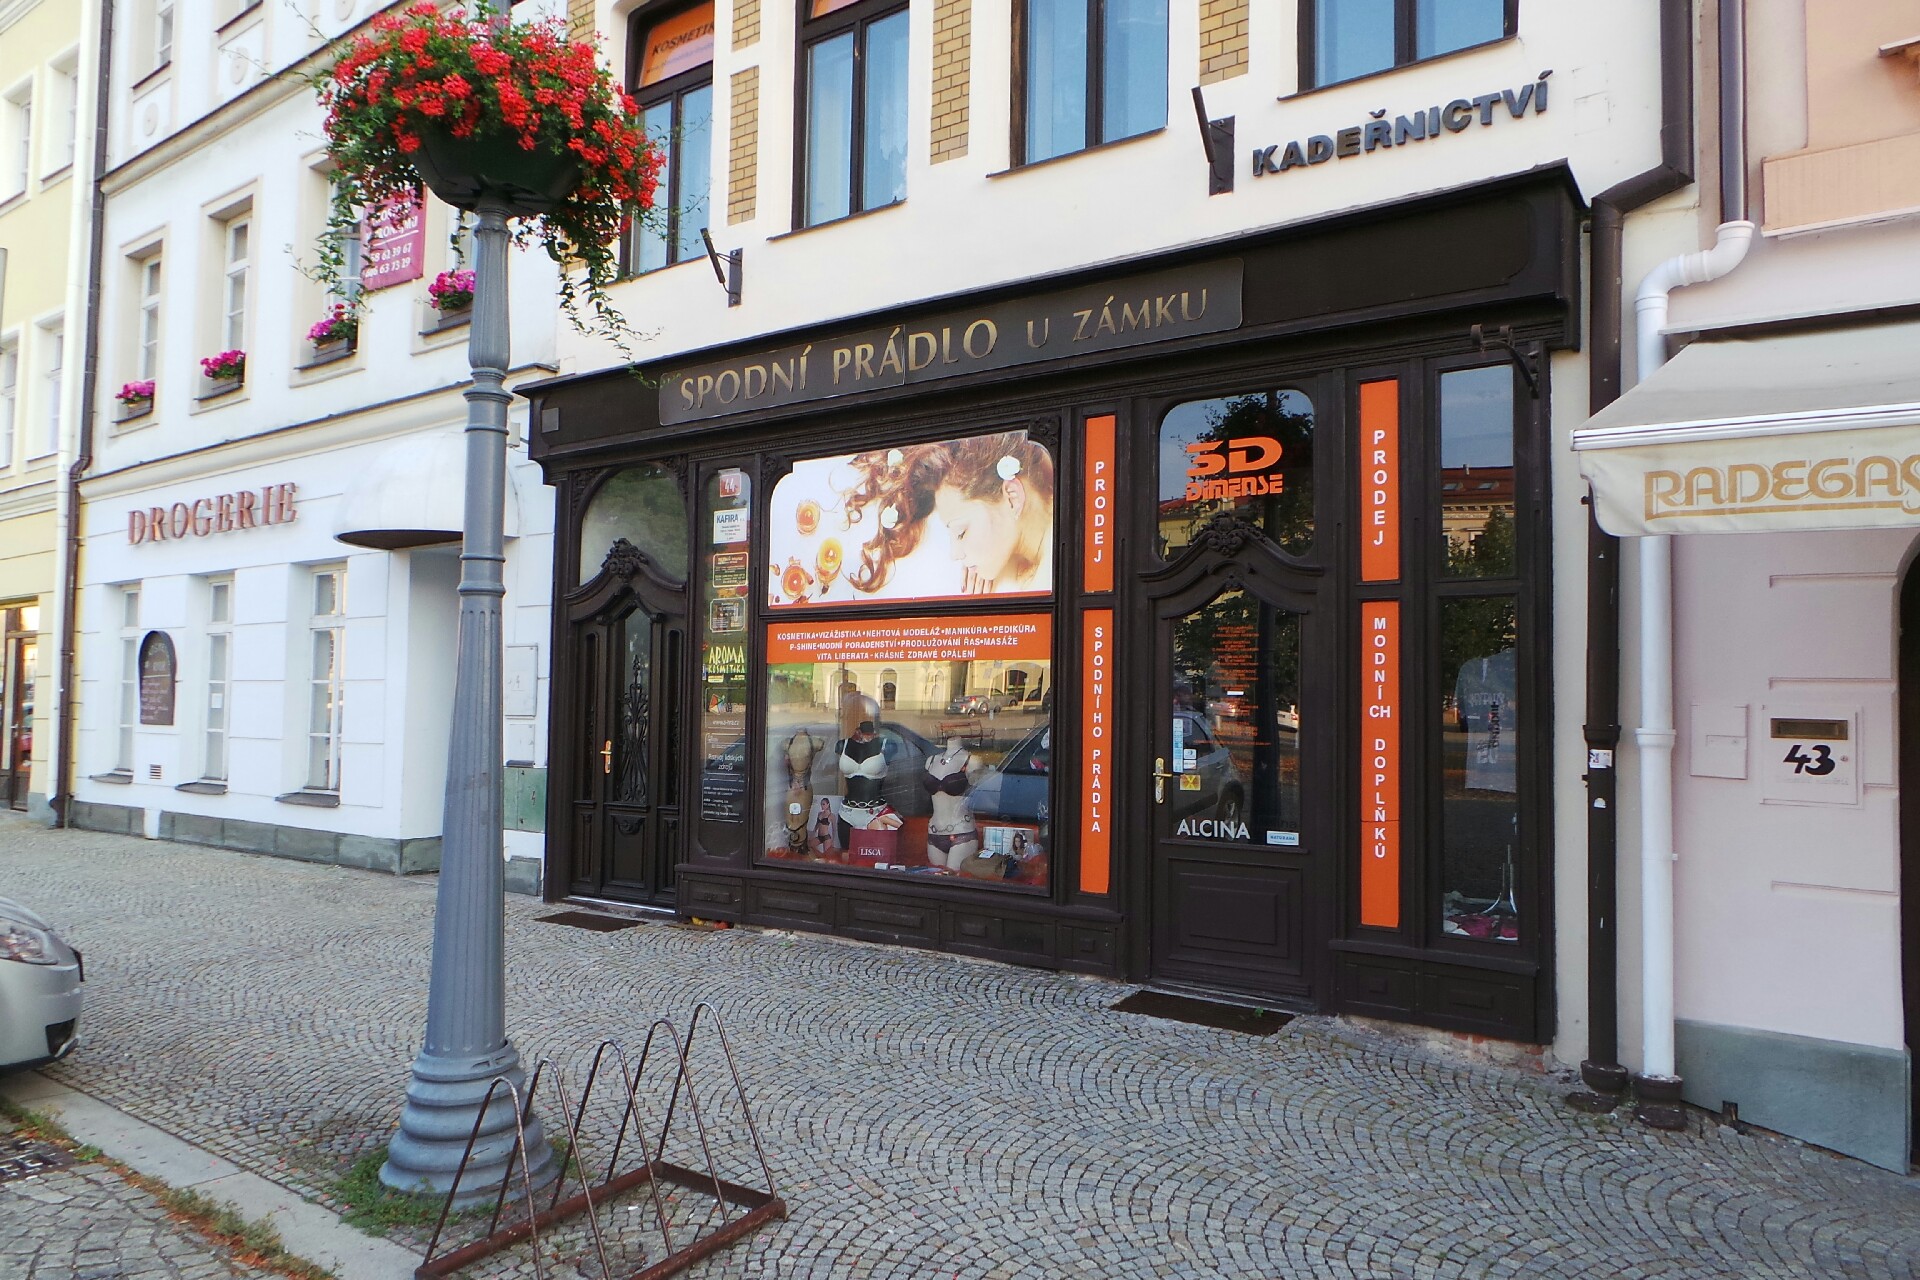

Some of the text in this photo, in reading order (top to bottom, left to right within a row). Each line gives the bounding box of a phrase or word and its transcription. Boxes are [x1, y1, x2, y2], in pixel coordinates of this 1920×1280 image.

[1252, 69, 1553, 177] KADEŘNICTVÍ
[680, 288, 1208, 411] SPODNÍ PRÁDLO U ZÁMKU
[724, 478, 736, 493] 44
[1373, 429, 1388, 546] PRODEJ
[127, 482, 297, 545] DROGERIE
[1093, 461, 1106, 563] PRODEJ
[777, 624, 1036, 640] KOSMETIKA VIZÁŽISTIKA NEHTOVÁ MODELÁŽ MANIKÚRA PEDIKÚRA
[789, 635, 1018, 651] P-SHINE MODNÍ PORADENSTVÍ PRODLUŽOVÁNÍ ŘAS MASÁŽE
[708, 645, 745, 665] AROMA
[817, 652, 832, 660] VITA
[835, 652, 869, 660] LIBERATA
[874, 650, 904, 659] KRÁSNÉ
[907, 649, 938, 658] ZDRAVÉ
[941, 648, 976, 658] OPÁLENÍ
[1091, 626, 1104, 833] SPODNÍHO PRÁDLA
[1369, 617, 1391, 859] MODNÍCH DOPLŇKŮ
[1783, 745, 1836, 776] 43
[1176, 819, 1251, 840] ALCINA
[860, 848, 881, 856] LISCA
